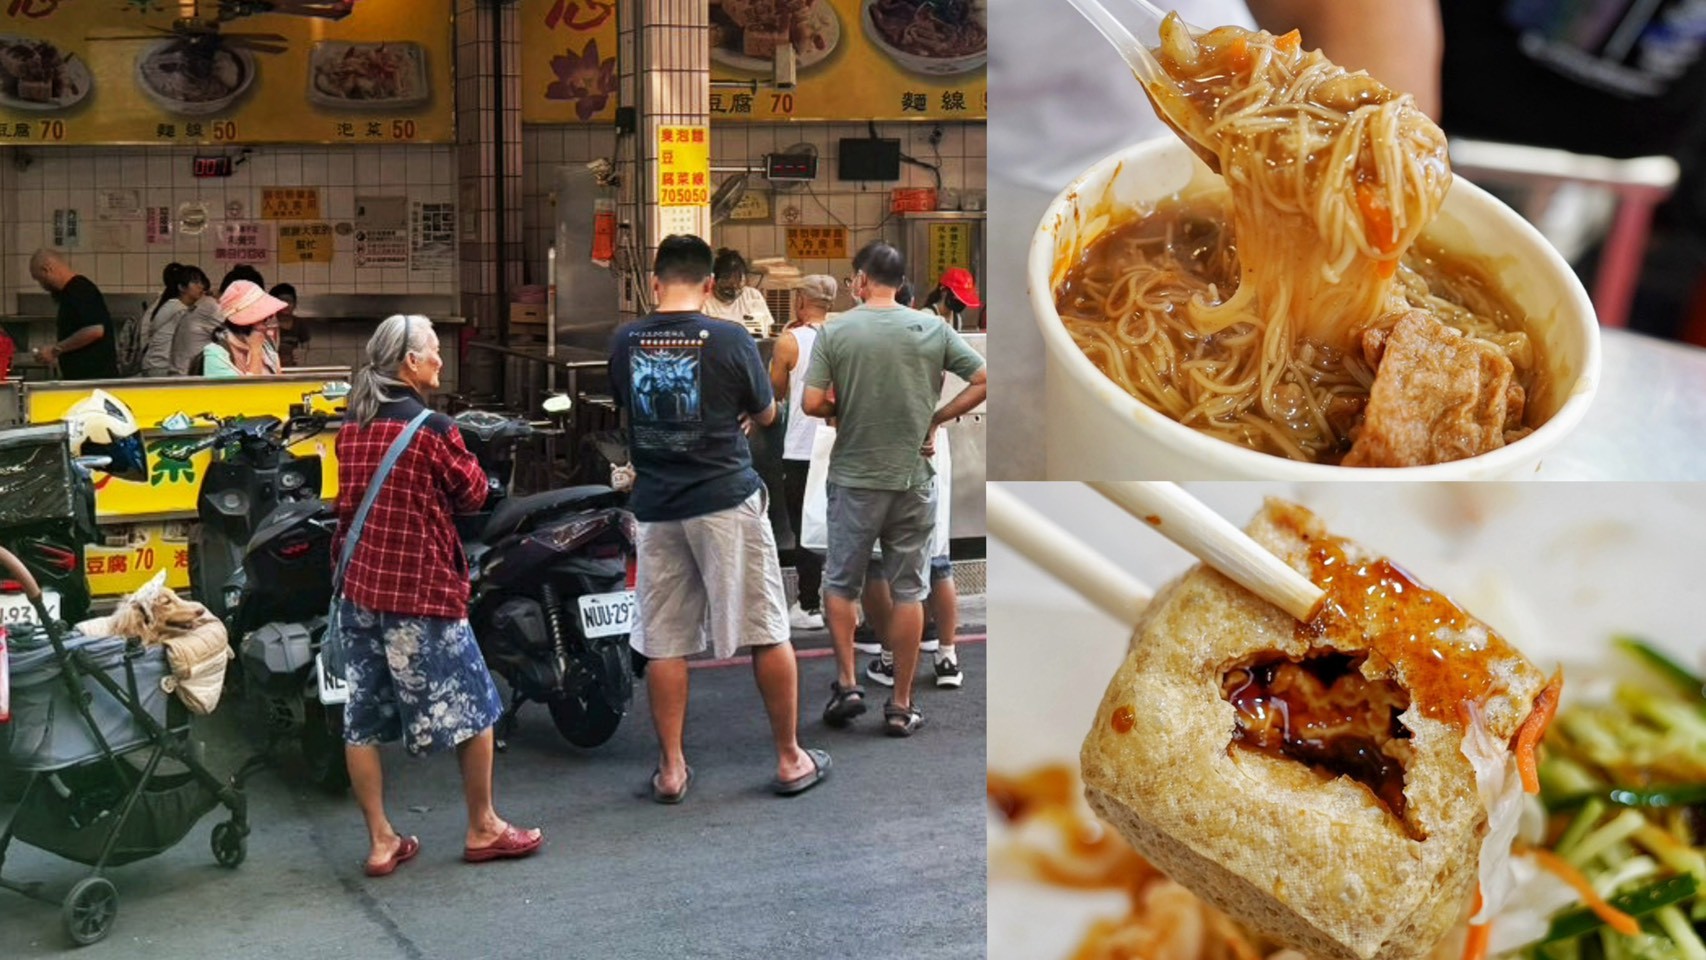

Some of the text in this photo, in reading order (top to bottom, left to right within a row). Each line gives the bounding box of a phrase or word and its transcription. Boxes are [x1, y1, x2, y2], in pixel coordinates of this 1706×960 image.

[771, 94, 793, 113] 70
[902, 93, 966, 111] 麵線
[41, 121, 64, 139] 70
[213, 121, 236, 140] 50
[392, 120, 415, 139] 50
[86, 555, 128, 574] 豆腐
[135, 548, 154, 570] 70
[583, 602, 634, 628] NUU-29
